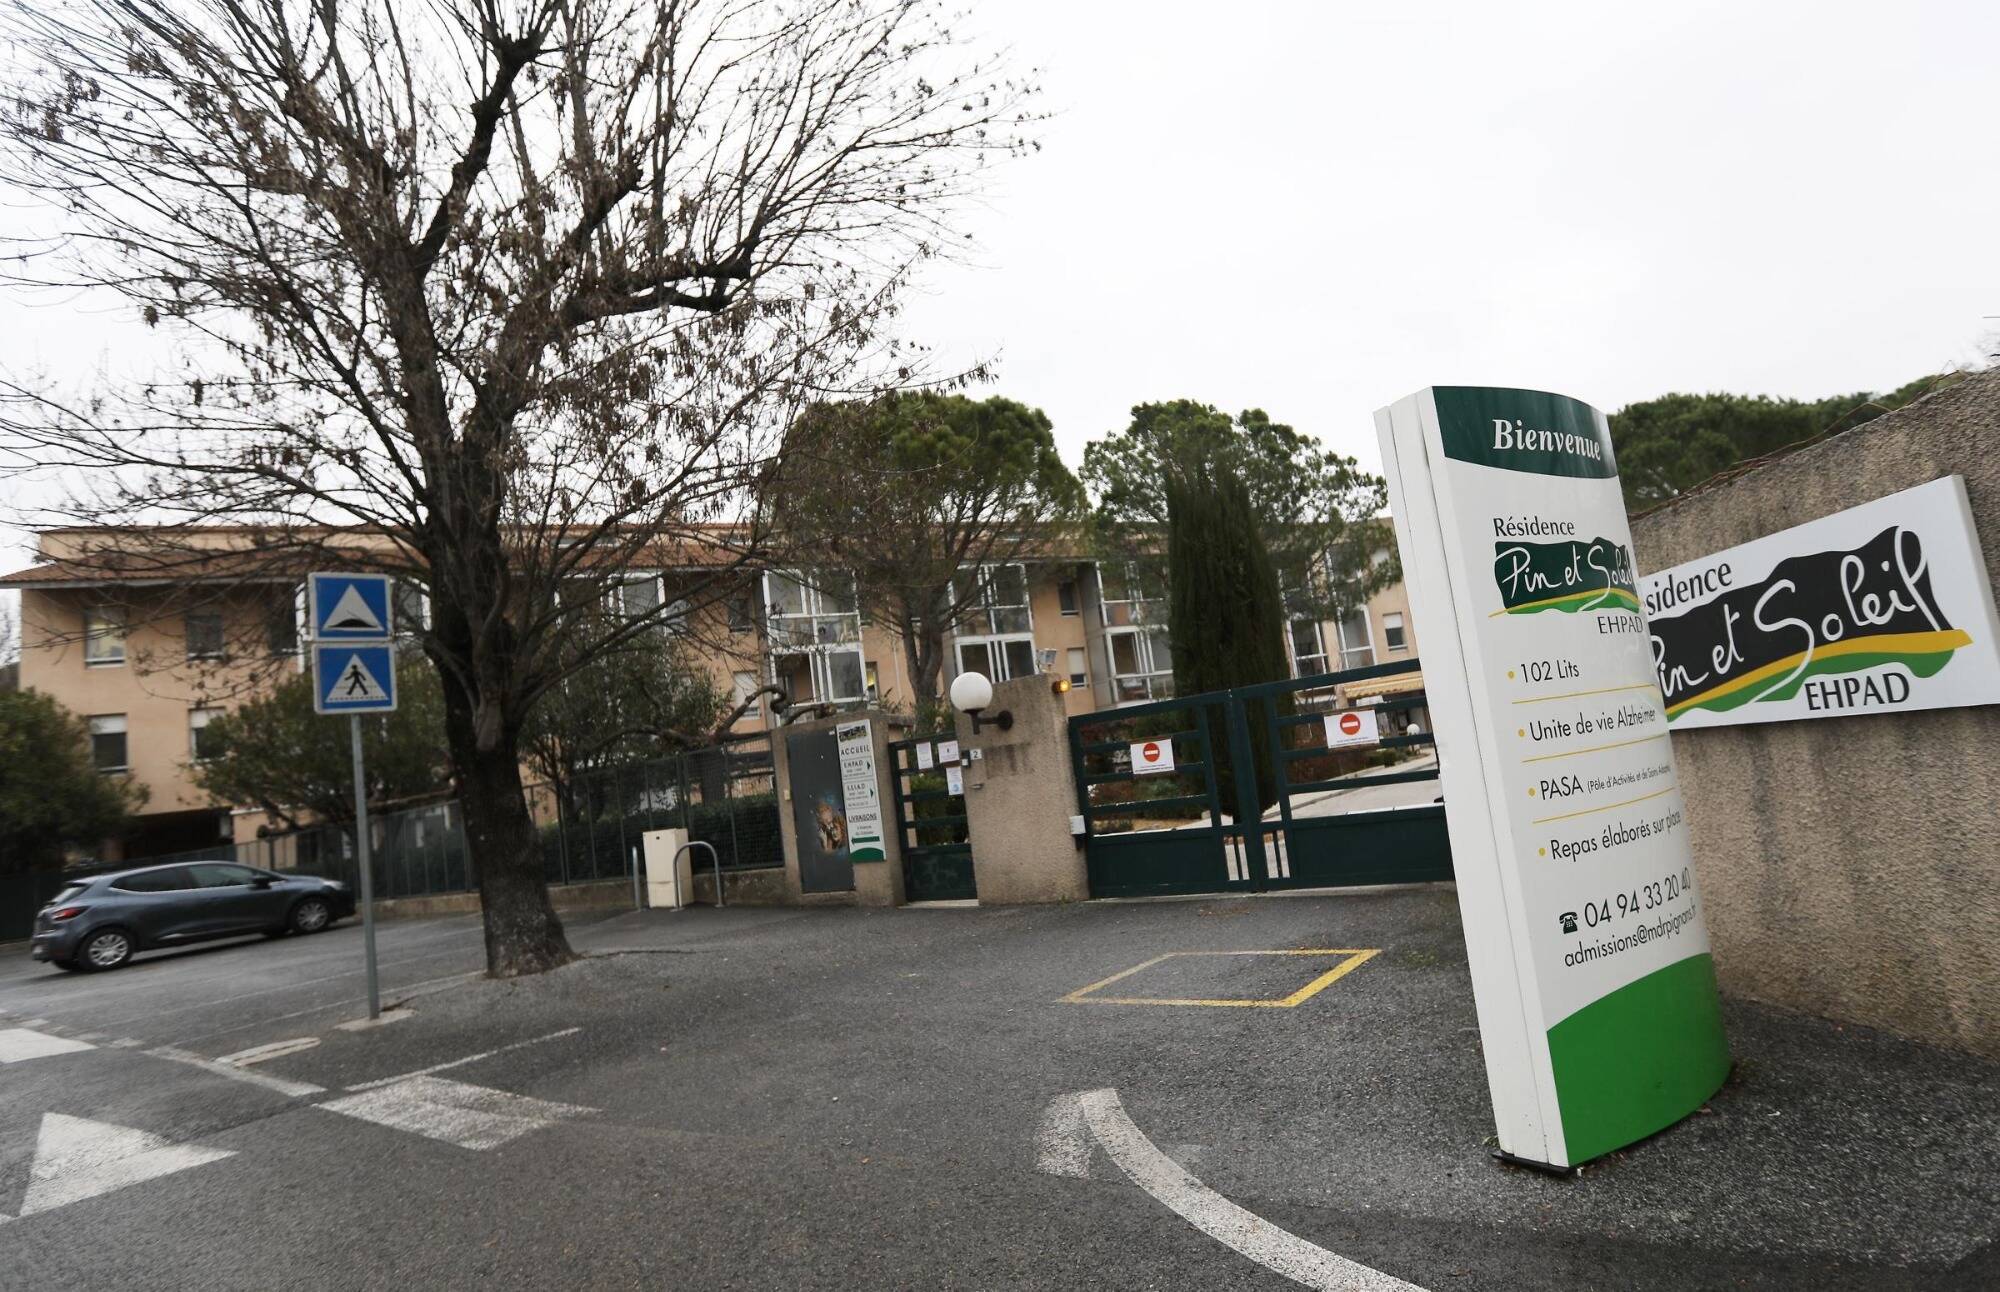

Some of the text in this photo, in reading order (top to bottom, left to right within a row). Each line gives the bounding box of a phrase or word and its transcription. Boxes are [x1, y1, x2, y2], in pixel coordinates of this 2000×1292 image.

[1492, 419, 1602, 462] Bienvenue
[1493, 517, 1576, 537] Résidence
[1496, 545, 1633, 611] Pin et Soleil
[1646, 562, 1733, 616] sidence
[1598, 616, 1644, 636] EHPAD
[1712, 603, 1744, 675] et
[1748, 526, 1942, 703] Soleil
[1520, 659, 1580, 683] 102 Lits
[1804, 672, 1911, 711] EHPAD
[1529, 704, 1656, 741] Unite de vie Alzheimer
[841, 744, 870, 756] ACCUEIL
[1540, 774, 1584, 800] PASA
[1587, 776, 1605, 793] (Pôle
[1550, 808, 1682, 862] Repas élaborés sur place
[1584, 866, 1691, 928] 04 94 33 20 40
